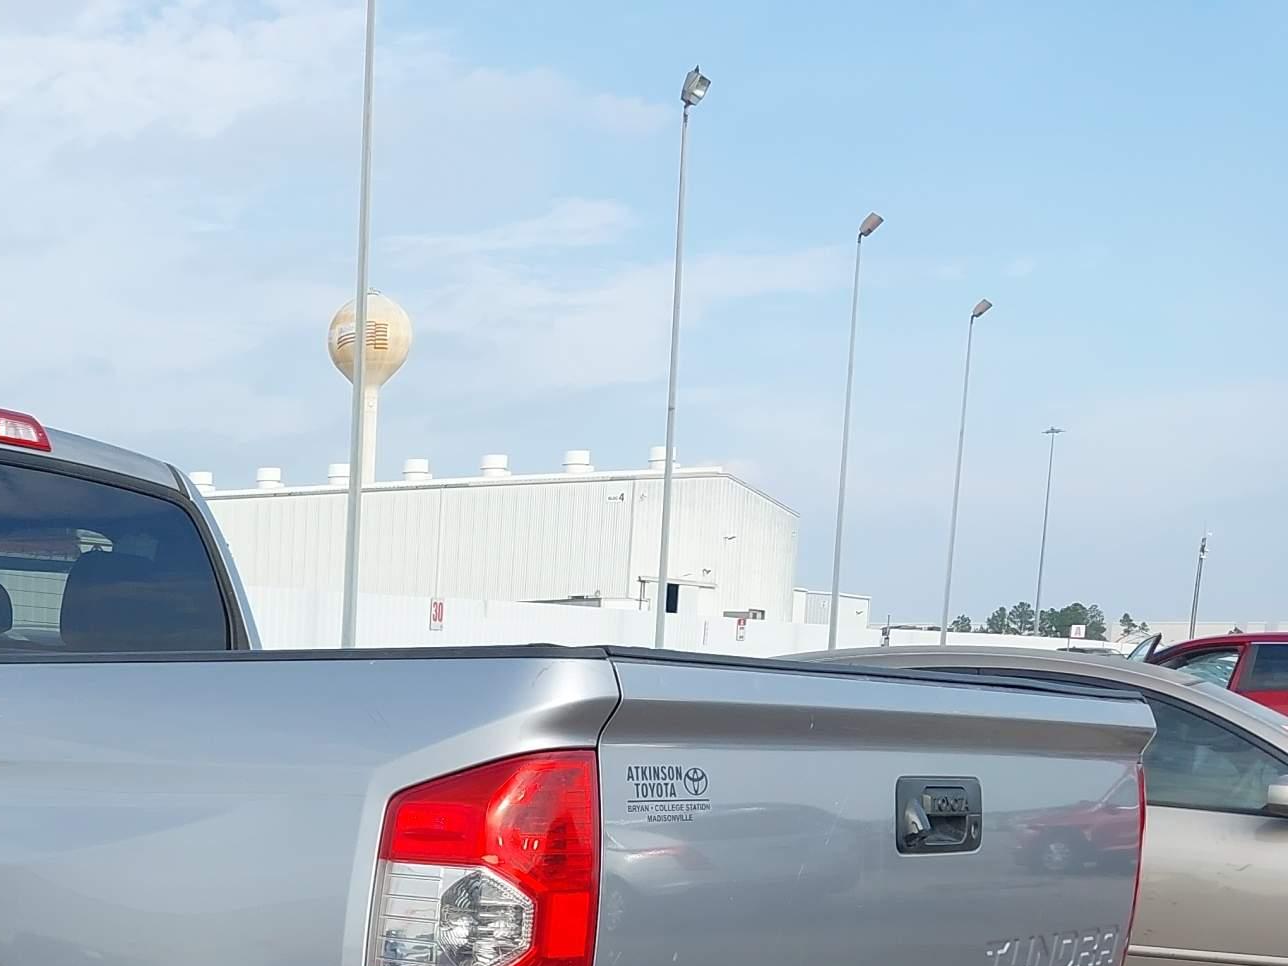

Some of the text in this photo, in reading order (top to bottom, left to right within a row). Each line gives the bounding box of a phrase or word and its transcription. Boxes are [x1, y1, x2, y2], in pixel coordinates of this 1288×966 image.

[432, 601, 444, 622] 30
[626, 765, 682, 781] ATKINSON
[634, 782, 677, 798] TOYOTA
[627, 803, 711, 813] BRYAN COLLEGE STATION
[647, 814, 694, 822] MADISONVILLE
